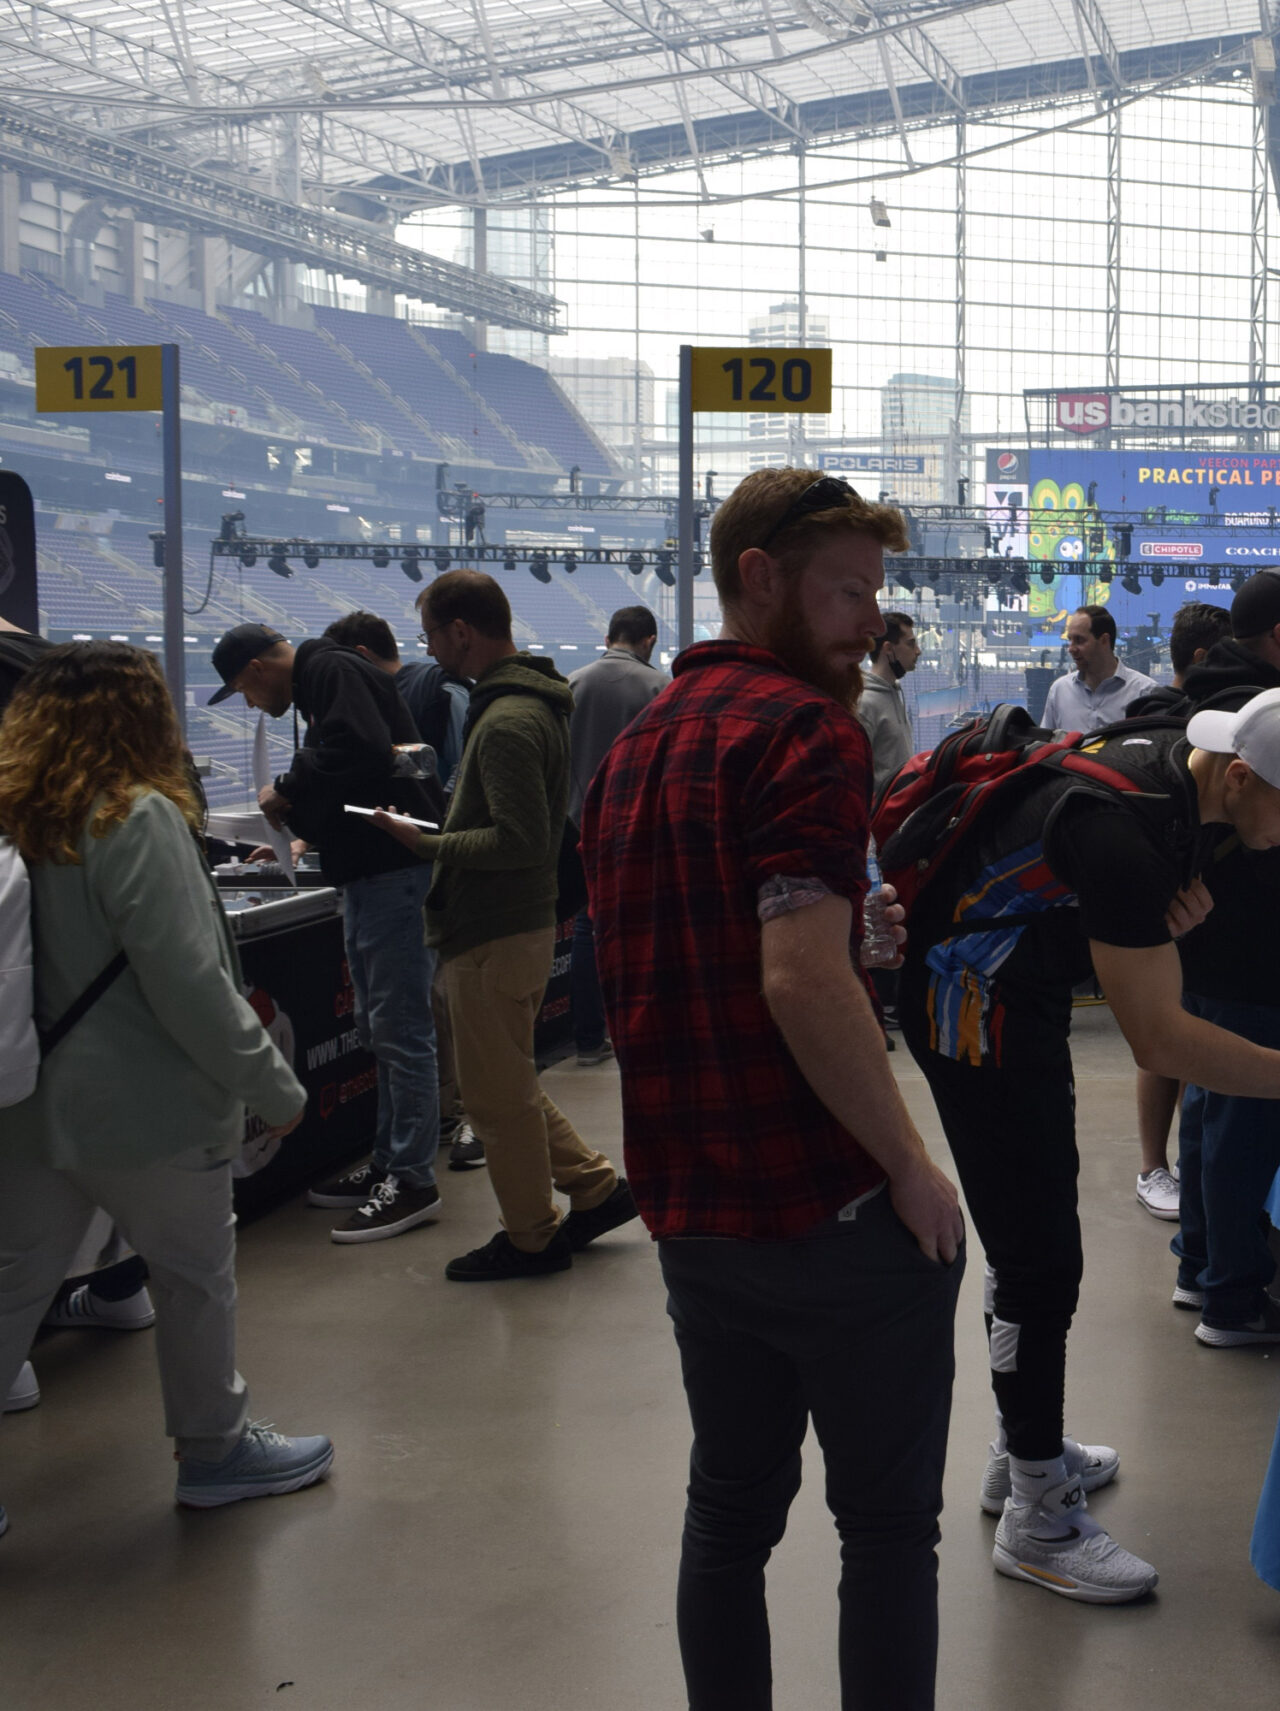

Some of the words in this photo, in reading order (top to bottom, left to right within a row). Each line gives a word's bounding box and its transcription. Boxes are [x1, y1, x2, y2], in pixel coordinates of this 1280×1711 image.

[64, 355, 138, 401] 121
[722, 357, 813, 403] 120
[823, 456, 919, 471] POLARIS
[1199, 457, 1249, 468] VEECON
[1138, 467, 1254, 486] PRACTICAL
[1154, 546, 1201, 555] CHIPOTLE
[306, 1028, 362, 1071] WWW.THE
